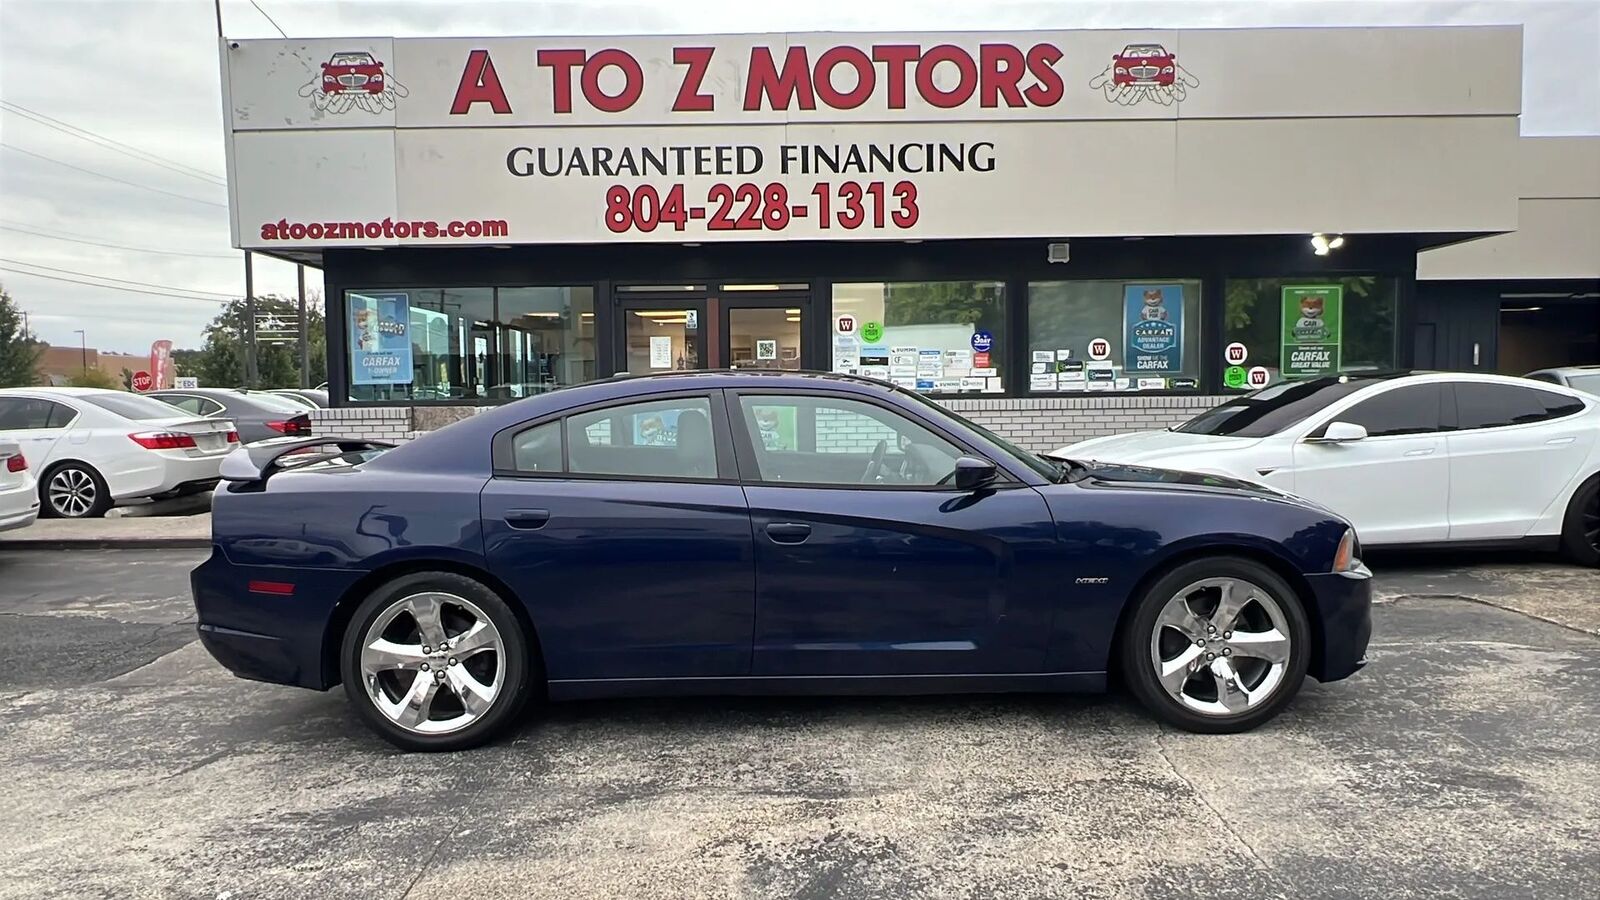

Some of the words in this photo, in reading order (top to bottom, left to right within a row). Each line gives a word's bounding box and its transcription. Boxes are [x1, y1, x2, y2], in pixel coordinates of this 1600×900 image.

[450, 50, 512, 114] A
[537, 49, 643, 113] TO
[672, 47, 715, 112] Z
[743, 44, 1065, 112] MOTORS
[507, 146, 763, 177] GUARANTEED
[781, 142, 996, 174] FINANCING
[605, 181, 920, 234] 804-228-1313
[261, 218, 508, 240] atoozmotors.com
[840, 320, 852, 330] W
[973, 334, 980, 344] 3
[1093, 345, 1106, 355] W
[1230, 349, 1242, 359] W
[362, 356, 401, 367] CARFAX
[1291, 351, 1330, 362] CARFAX
[1137, 361, 1169, 369] CARFAX
[133, 376, 151, 387] STOP
[1252, 373, 1264, 383] W
